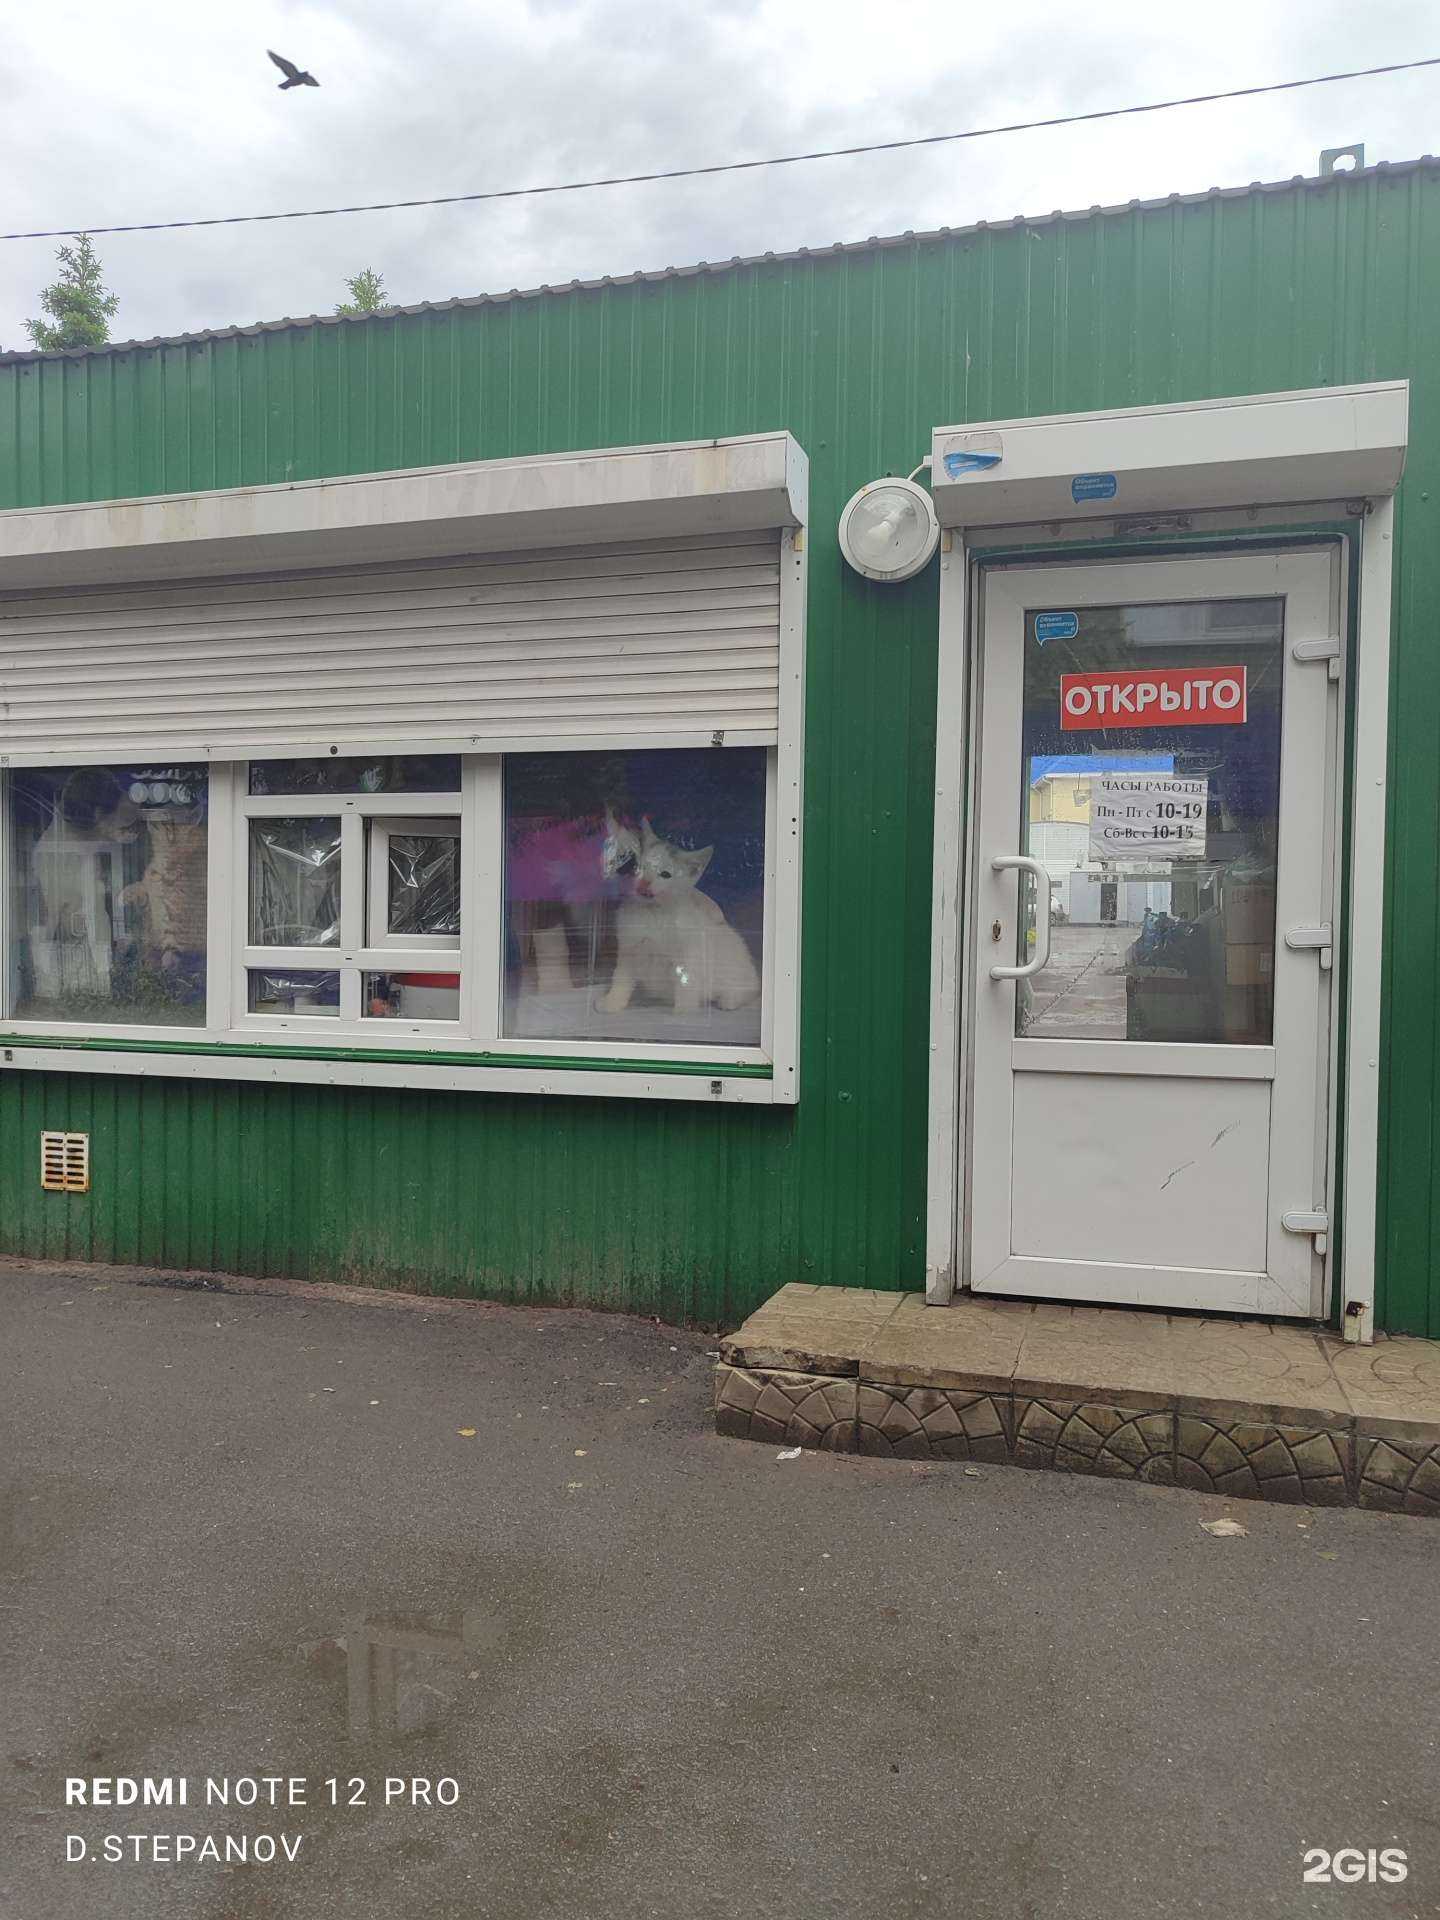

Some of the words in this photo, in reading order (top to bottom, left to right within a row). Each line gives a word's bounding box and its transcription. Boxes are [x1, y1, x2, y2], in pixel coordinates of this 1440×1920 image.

[1065, 679, 1241, 715] ОТКРЫТО
[1102, 781, 1141, 792] ЧАСЫ
[1146, 782, 1203, 793] РАБОТЫ
[1097, 806, 1115, 817] Пн
[1126, 806, 1143, 818] Пт
[1156, 802, 1203, 819] 10-19
[1104, 826, 1139, 839] Сб-Вс
[1151, 825, 1194, 840] 10-15
